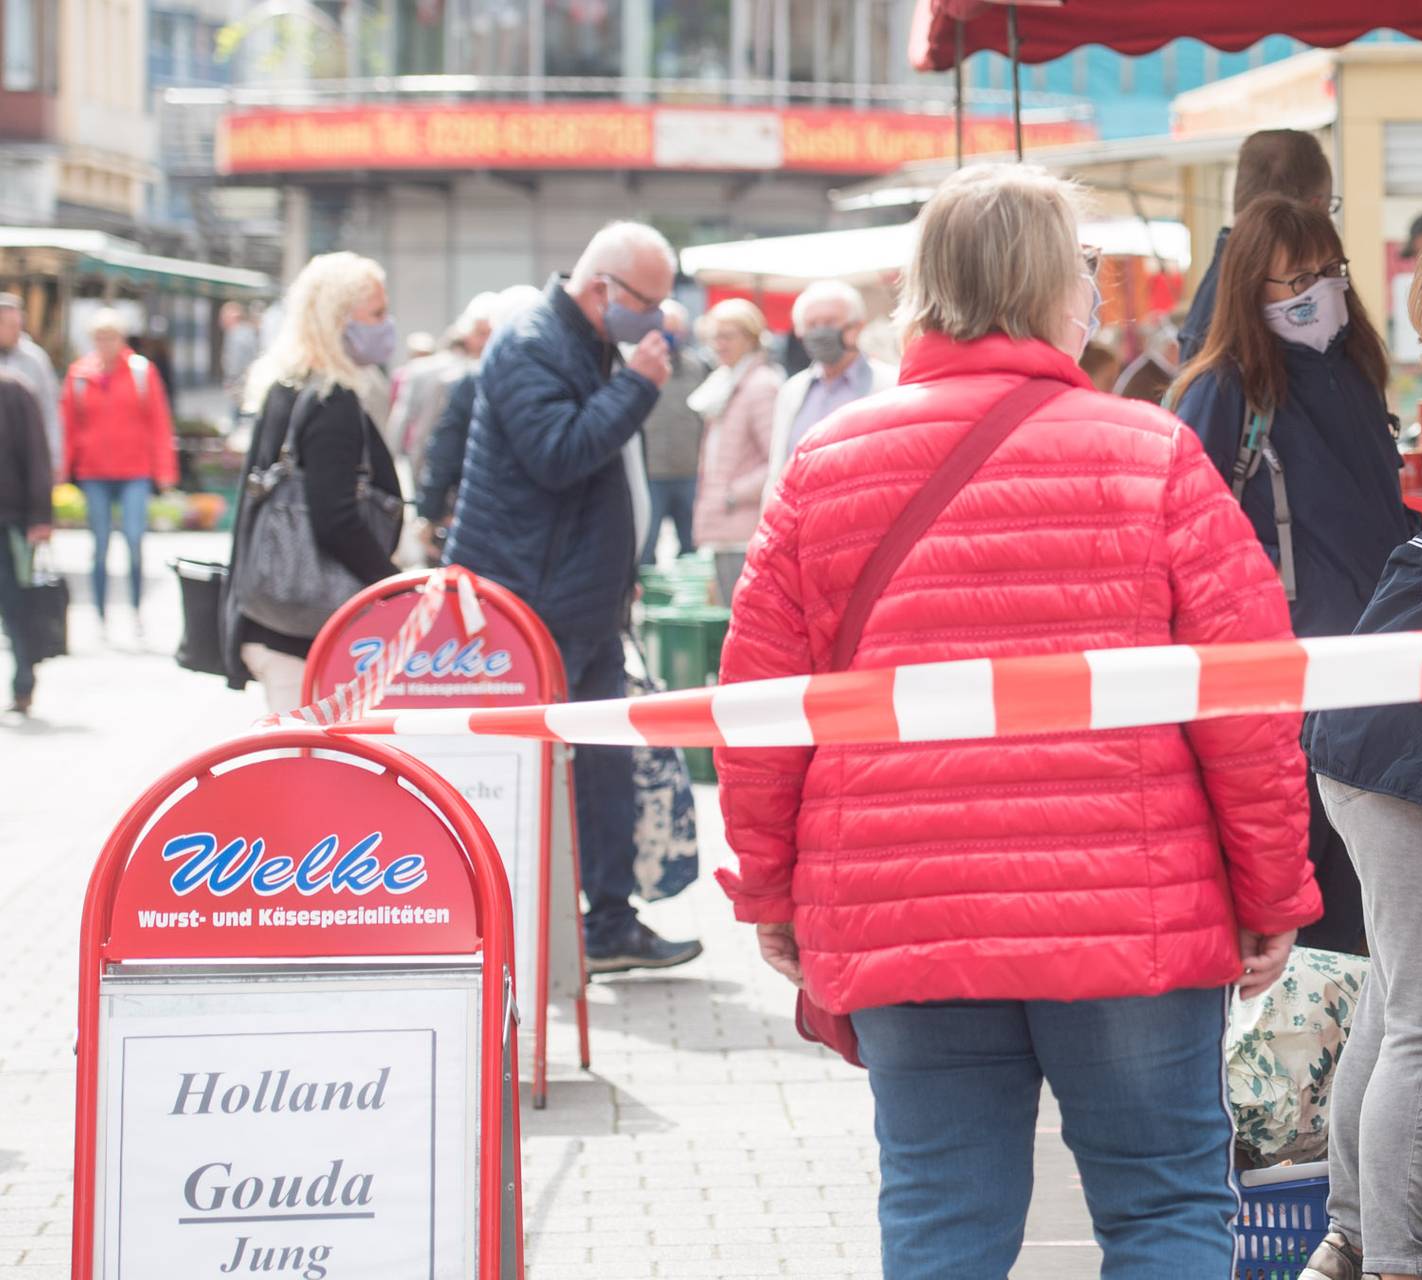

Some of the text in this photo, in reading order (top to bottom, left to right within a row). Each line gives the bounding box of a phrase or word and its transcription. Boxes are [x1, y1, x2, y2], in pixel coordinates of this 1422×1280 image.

[162, 832, 428, 896] Welke
[138, 905, 450, 929] Wurst- und Käsespezialitäten
[168, 1066, 391, 1115] Holland
[183, 1158, 374, 1212] Gouda
[219, 1236, 334, 1280] Jung
